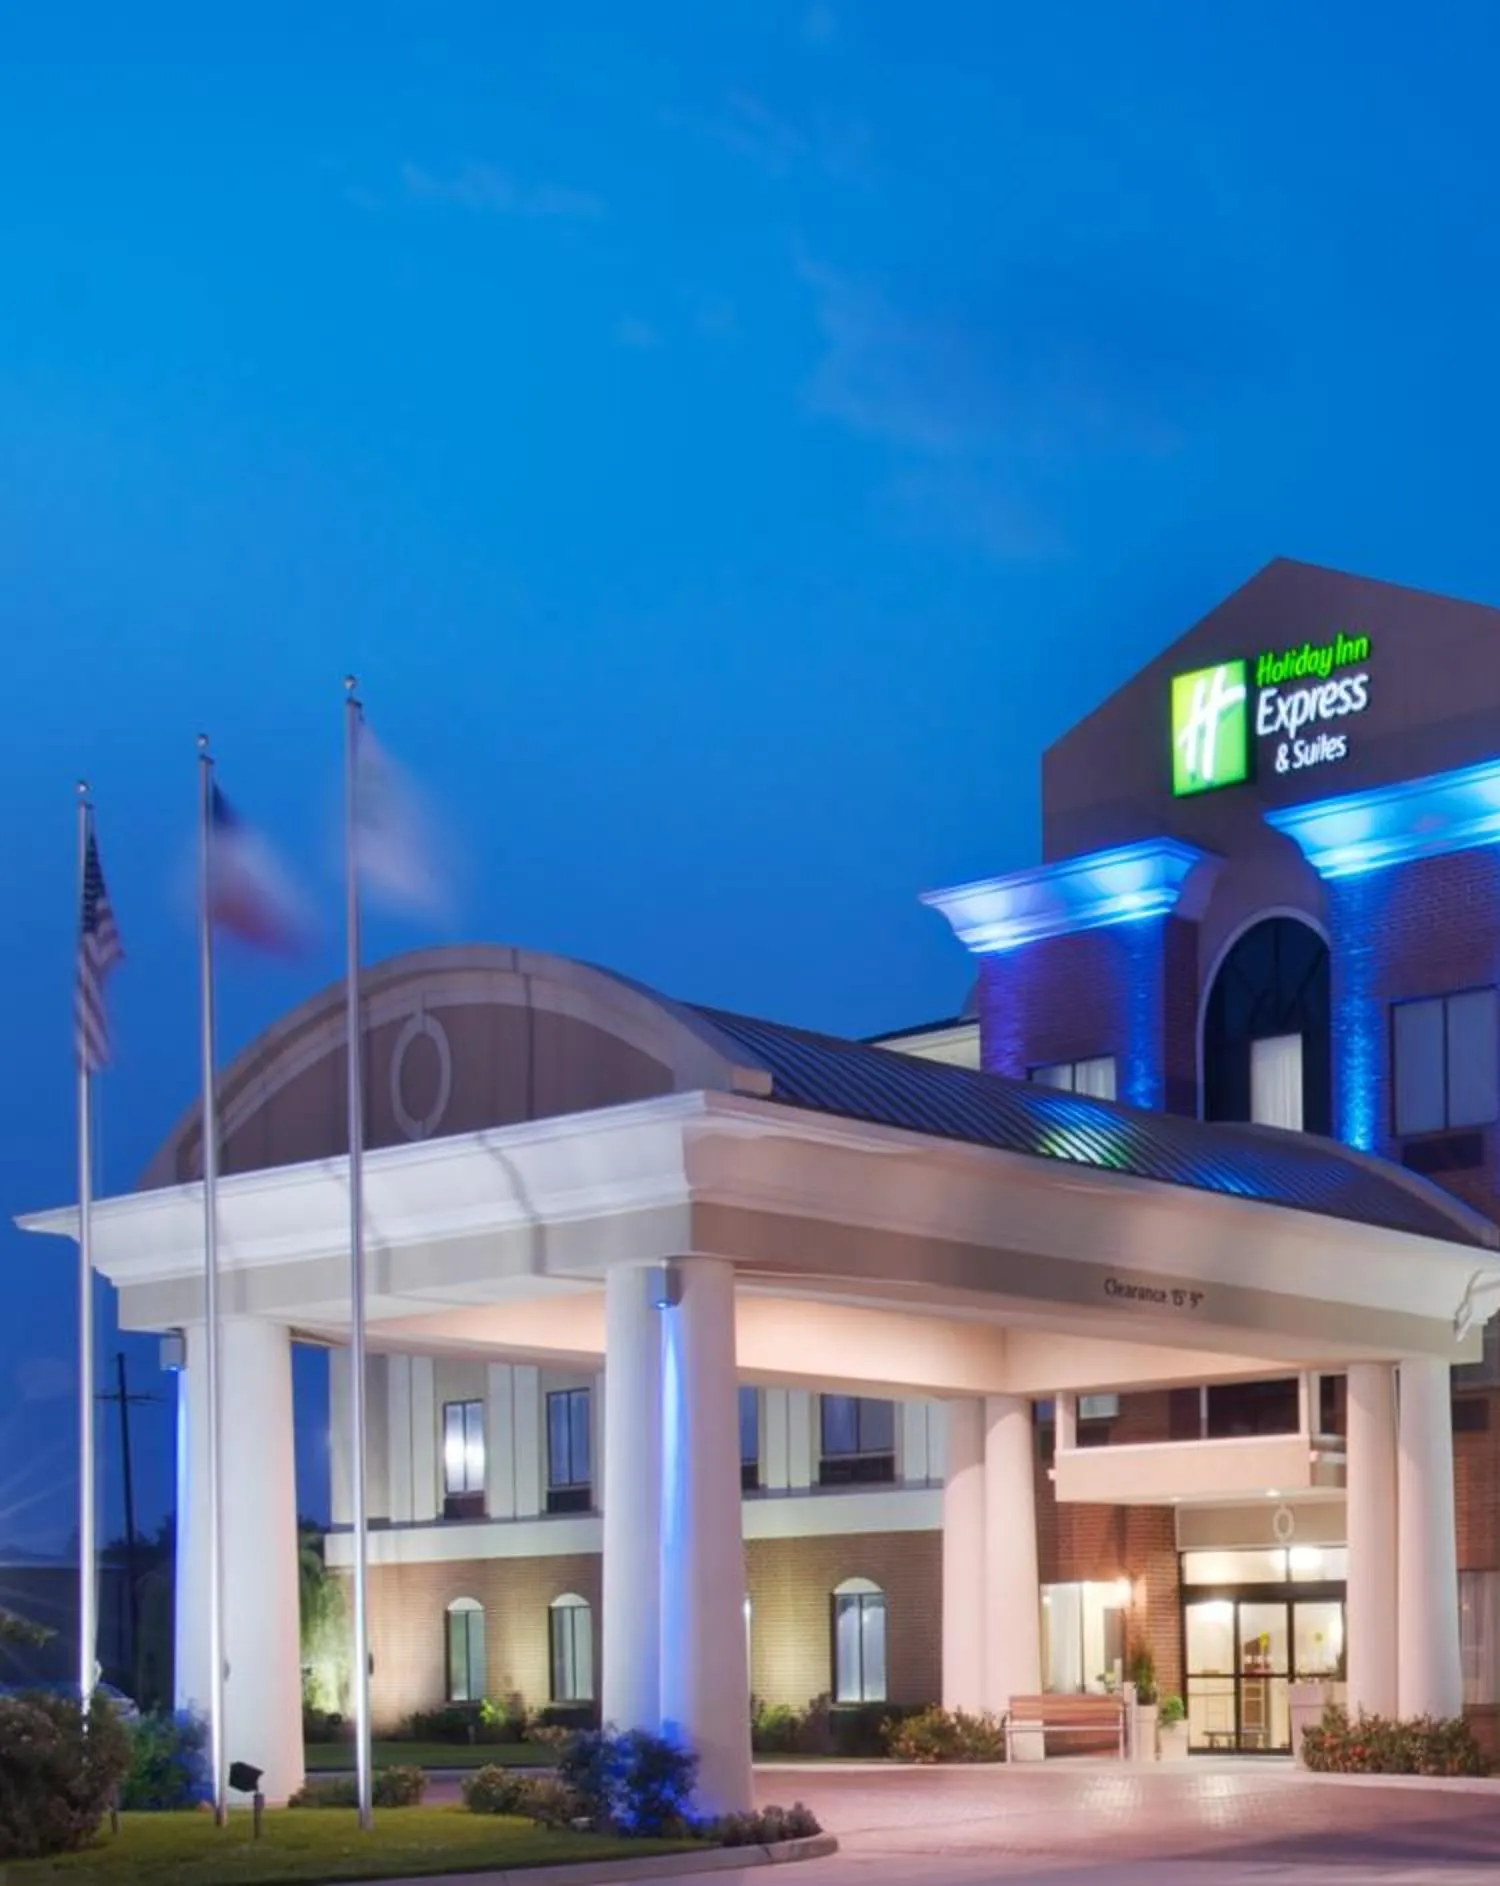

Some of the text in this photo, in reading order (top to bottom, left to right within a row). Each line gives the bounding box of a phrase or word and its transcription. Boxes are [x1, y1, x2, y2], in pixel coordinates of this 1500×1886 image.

[1256, 632, 1369, 686] Holiday Inn
[1256, 673, 1368, 739] Express
[1274, 733, 1346, 773] & Suites
[1104, 1277, 1167, 1303] Clearance
